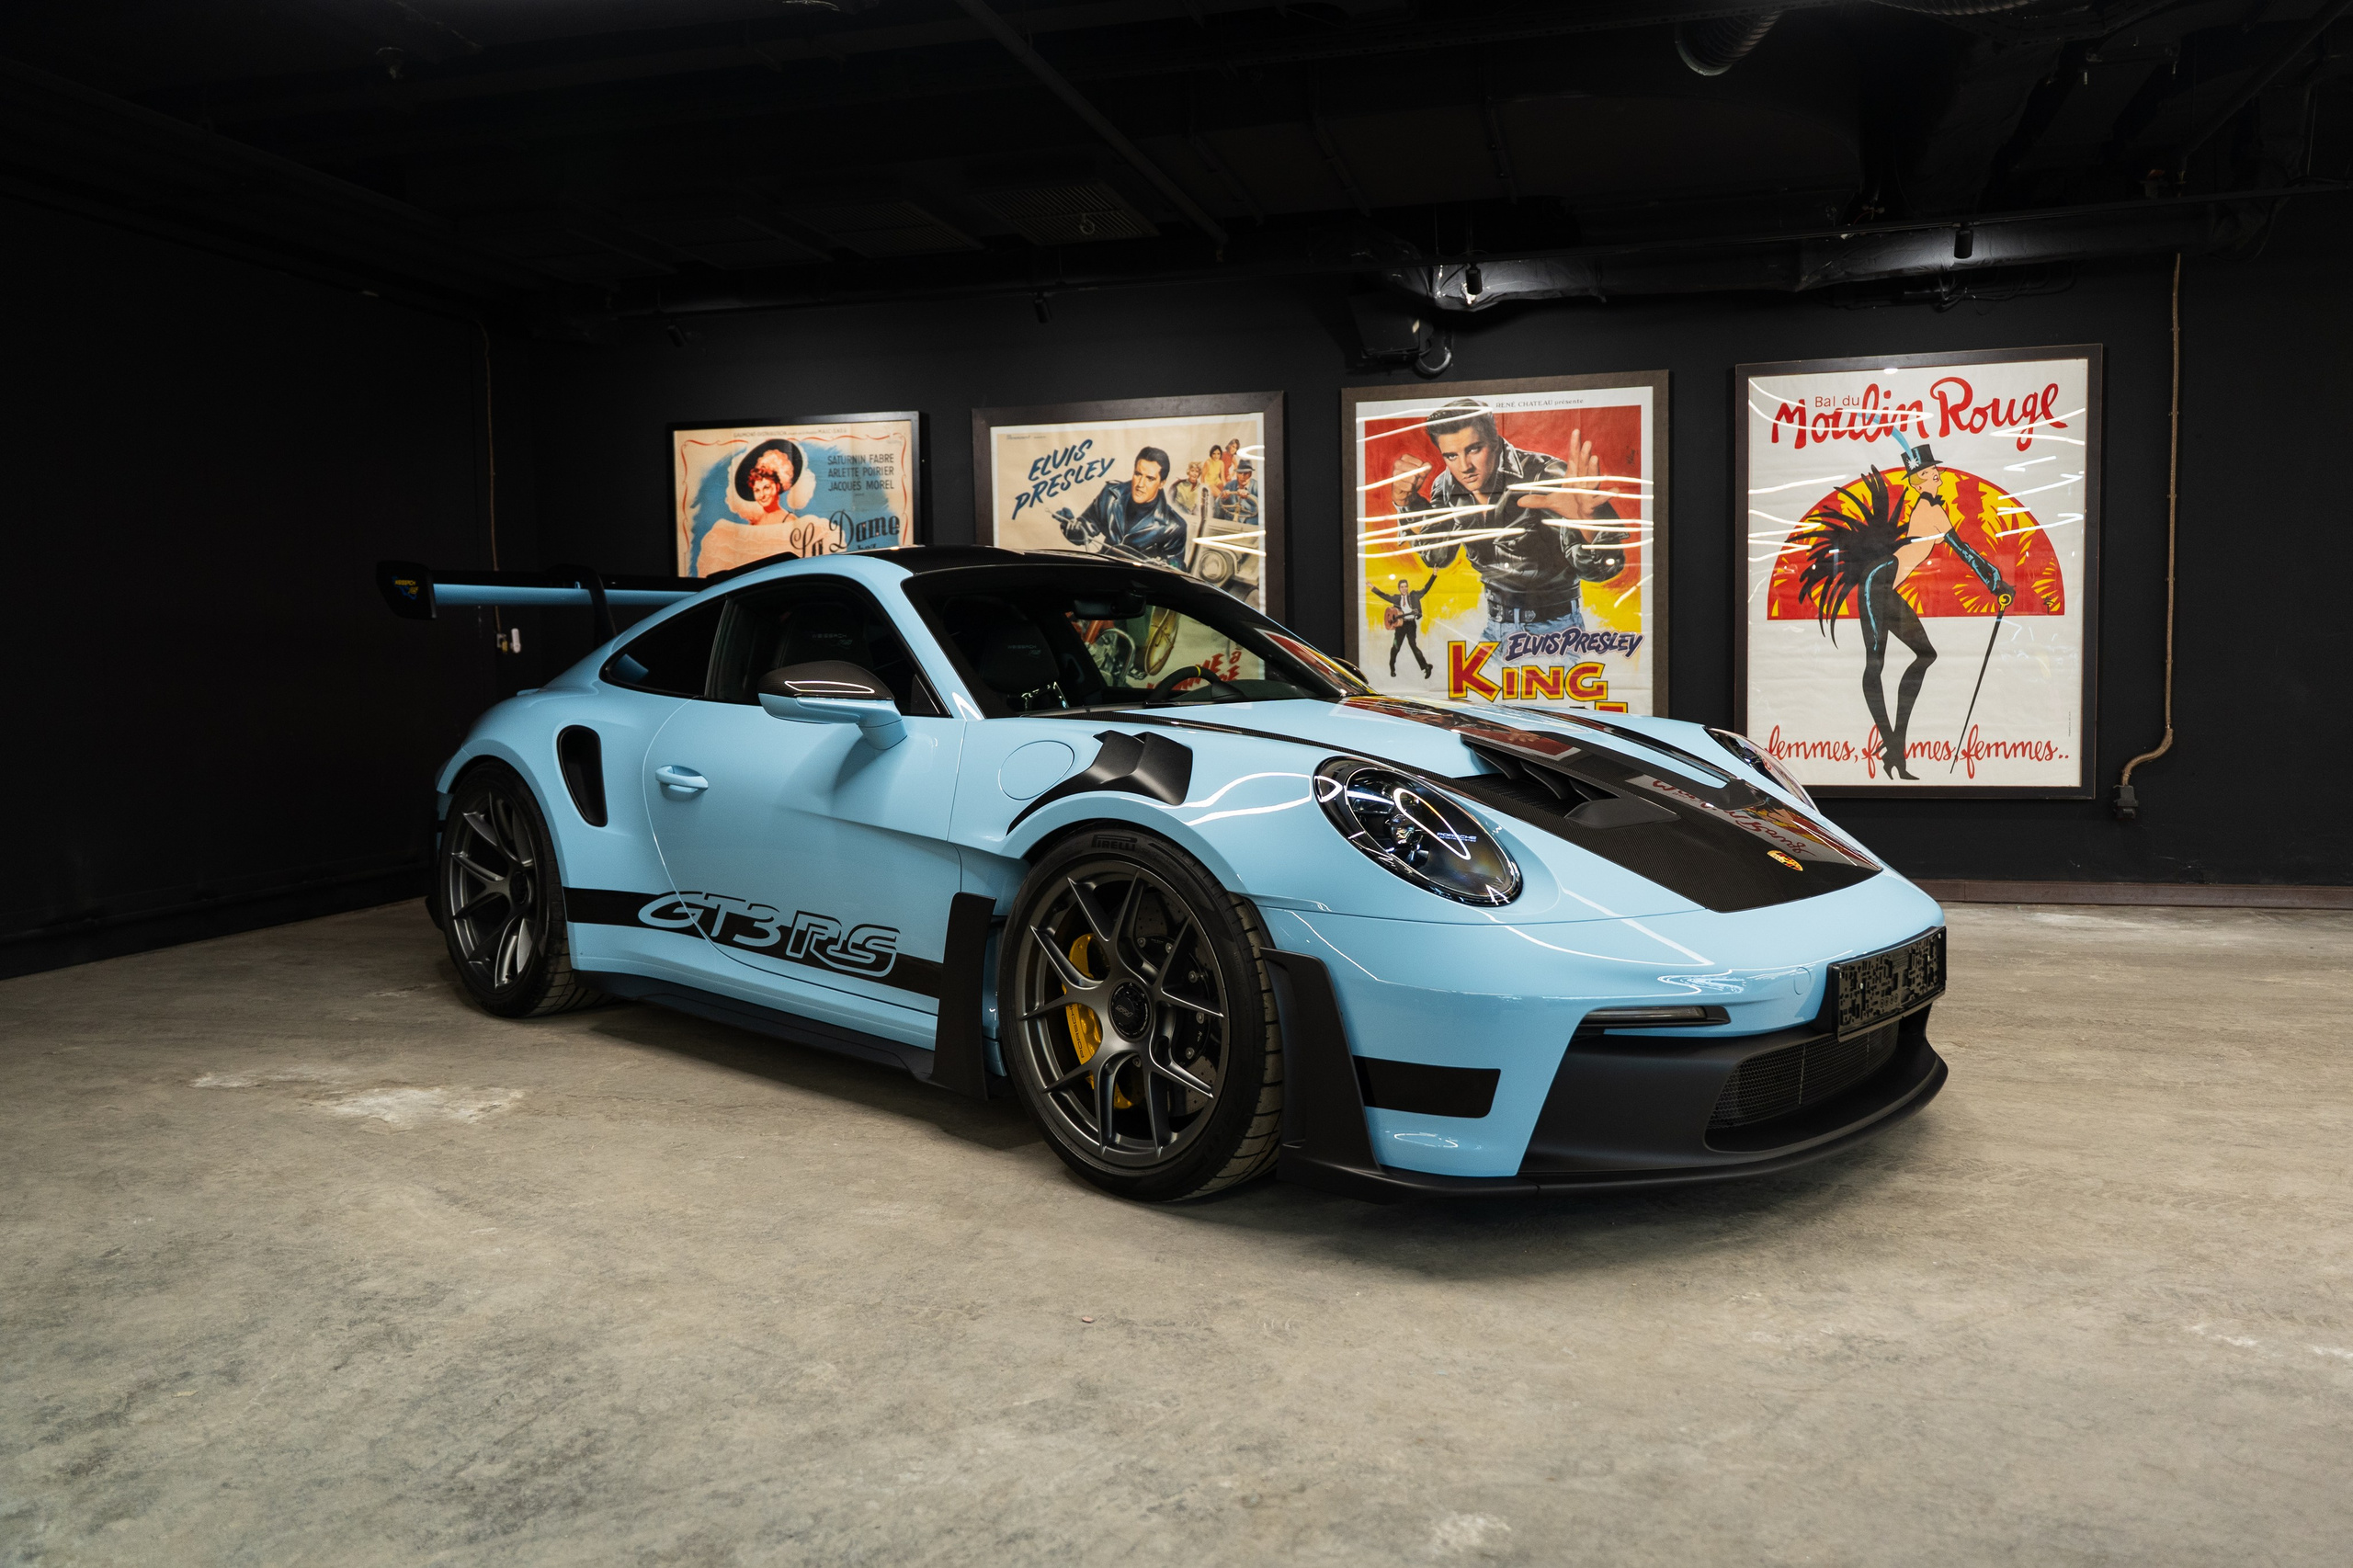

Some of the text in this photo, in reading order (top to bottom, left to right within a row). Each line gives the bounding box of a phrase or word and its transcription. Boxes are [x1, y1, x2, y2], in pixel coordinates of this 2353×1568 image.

[1771, 376, 2068, 452] Moulin Rouge
[1813, 394, 1859, 408] Bal du
[827, 453, 894, 465] SATURNIN FABRE
[828, 466, 894, 478] ARLETTE POIRIER
[1028, 438, 1093, 481] ELVIS
[828, 479, 894, 492] JACQUES MOREL
[1011, 458, 1115, 520] PRESLEY
[828, 510, 901, 553] Dame
[1505, 627, 1644, 662] ELVIS PRESLEY
[1448, 640, 1608, 702] KING
[1091, 834, 1138, 852] PIRELLI
